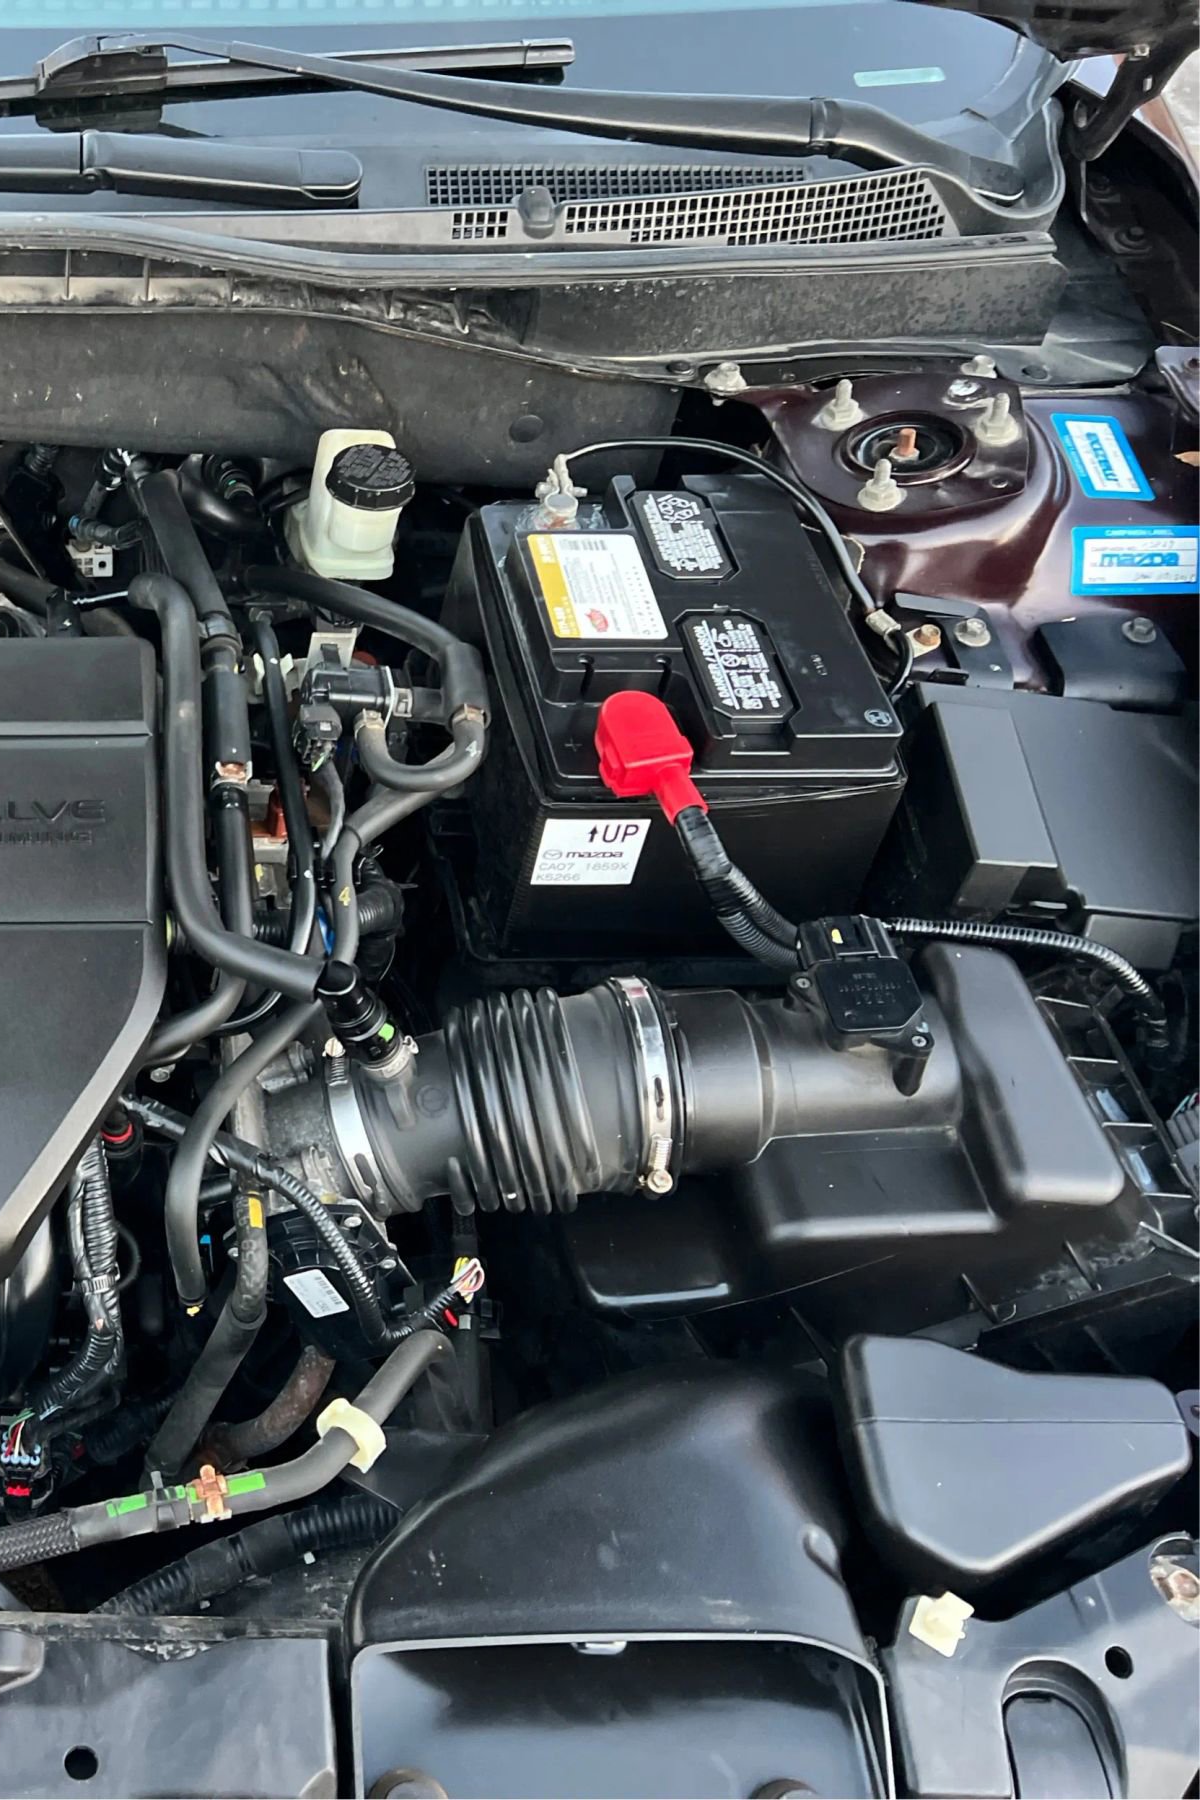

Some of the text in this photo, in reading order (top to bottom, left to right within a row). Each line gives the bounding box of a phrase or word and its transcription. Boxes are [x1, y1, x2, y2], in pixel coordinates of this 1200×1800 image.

[602, 824, 640, 843] UP
[566, 851, 624, 859] mazda
[539, 862, 576, 871] CA07
